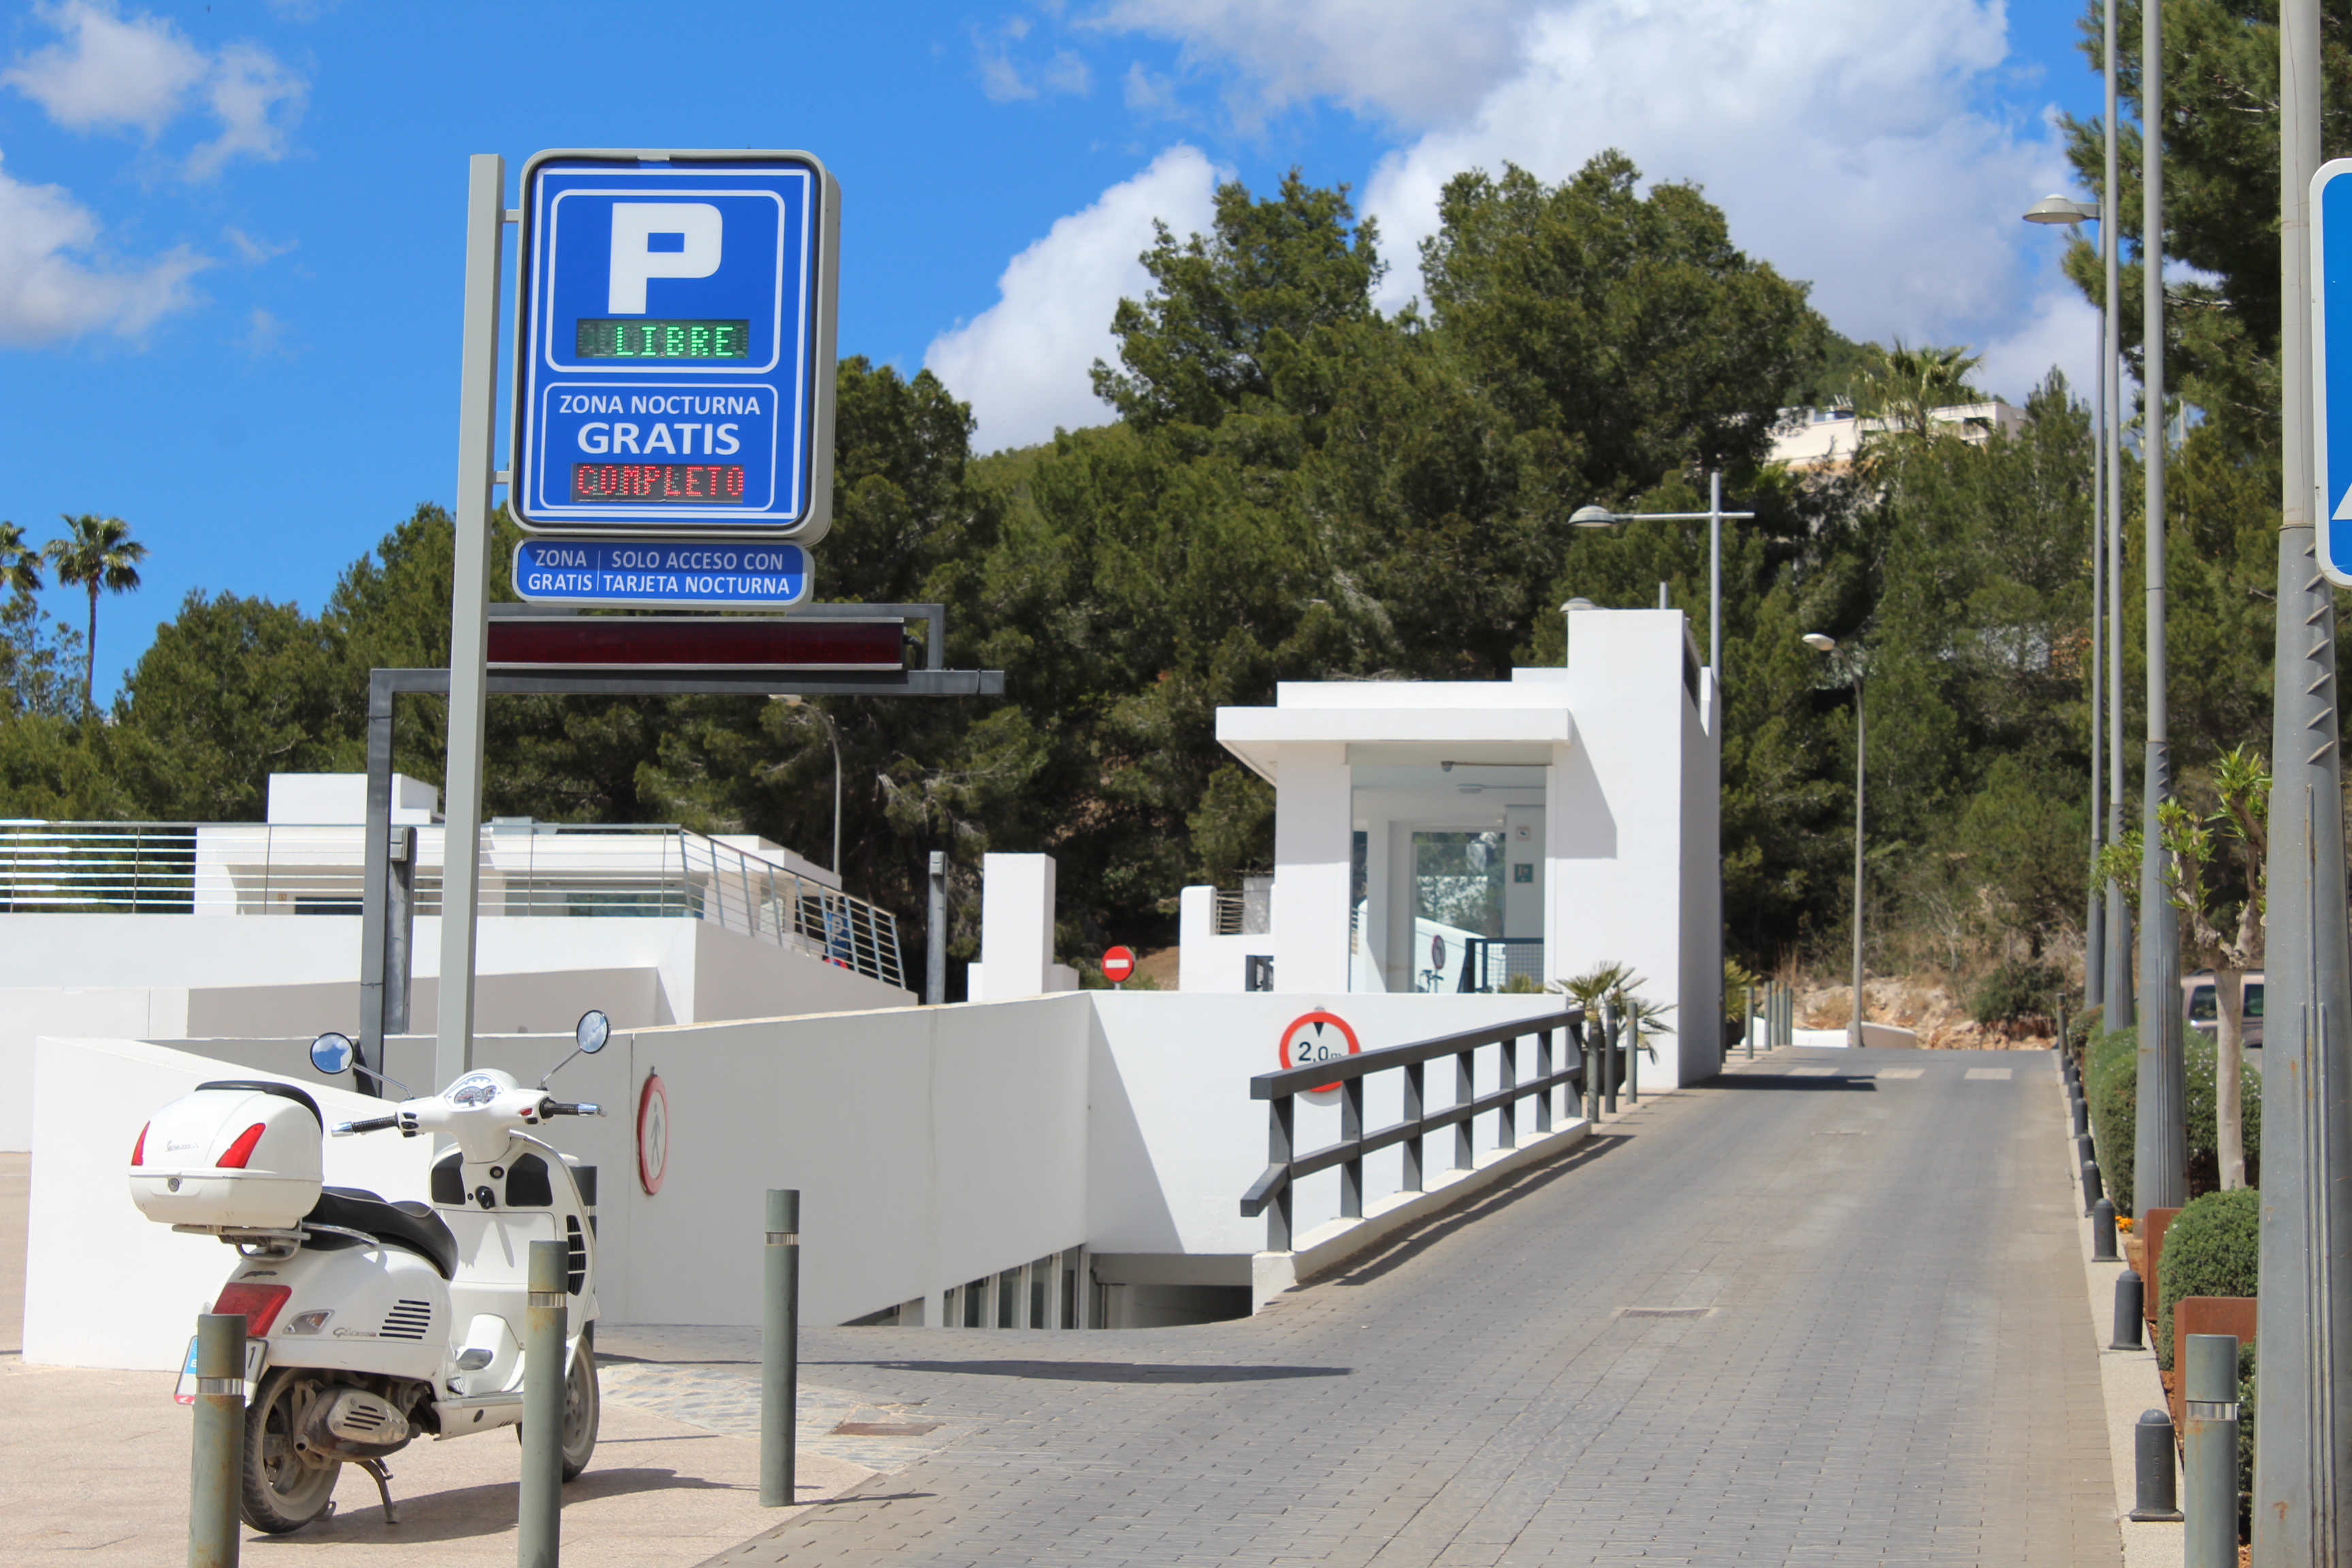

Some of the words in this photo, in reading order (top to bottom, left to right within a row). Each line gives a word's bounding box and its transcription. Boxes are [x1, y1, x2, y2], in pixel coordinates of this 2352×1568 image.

[608, 203, 723, 314] P
[616, 326, 734, 356] LIBRE
[559, 395, 623, 414] ZONA
[631, 396, 761, 416] NOCTURNA
[578, 423, 740, 455] GRATIS
[578, 466, 744, 495] COMPLETO
[536, 550, 587, 568] ZONA
[612, 551, 659, 570] SOLO
[666, 553, 737, 570] ACCESO
[744, 554, 783, 570] CON
[528, 574, 592, 591] GRATIS
[604, 576, 678, 593] TARJETA
[685, 576, 789, 595] NOCTURNA
